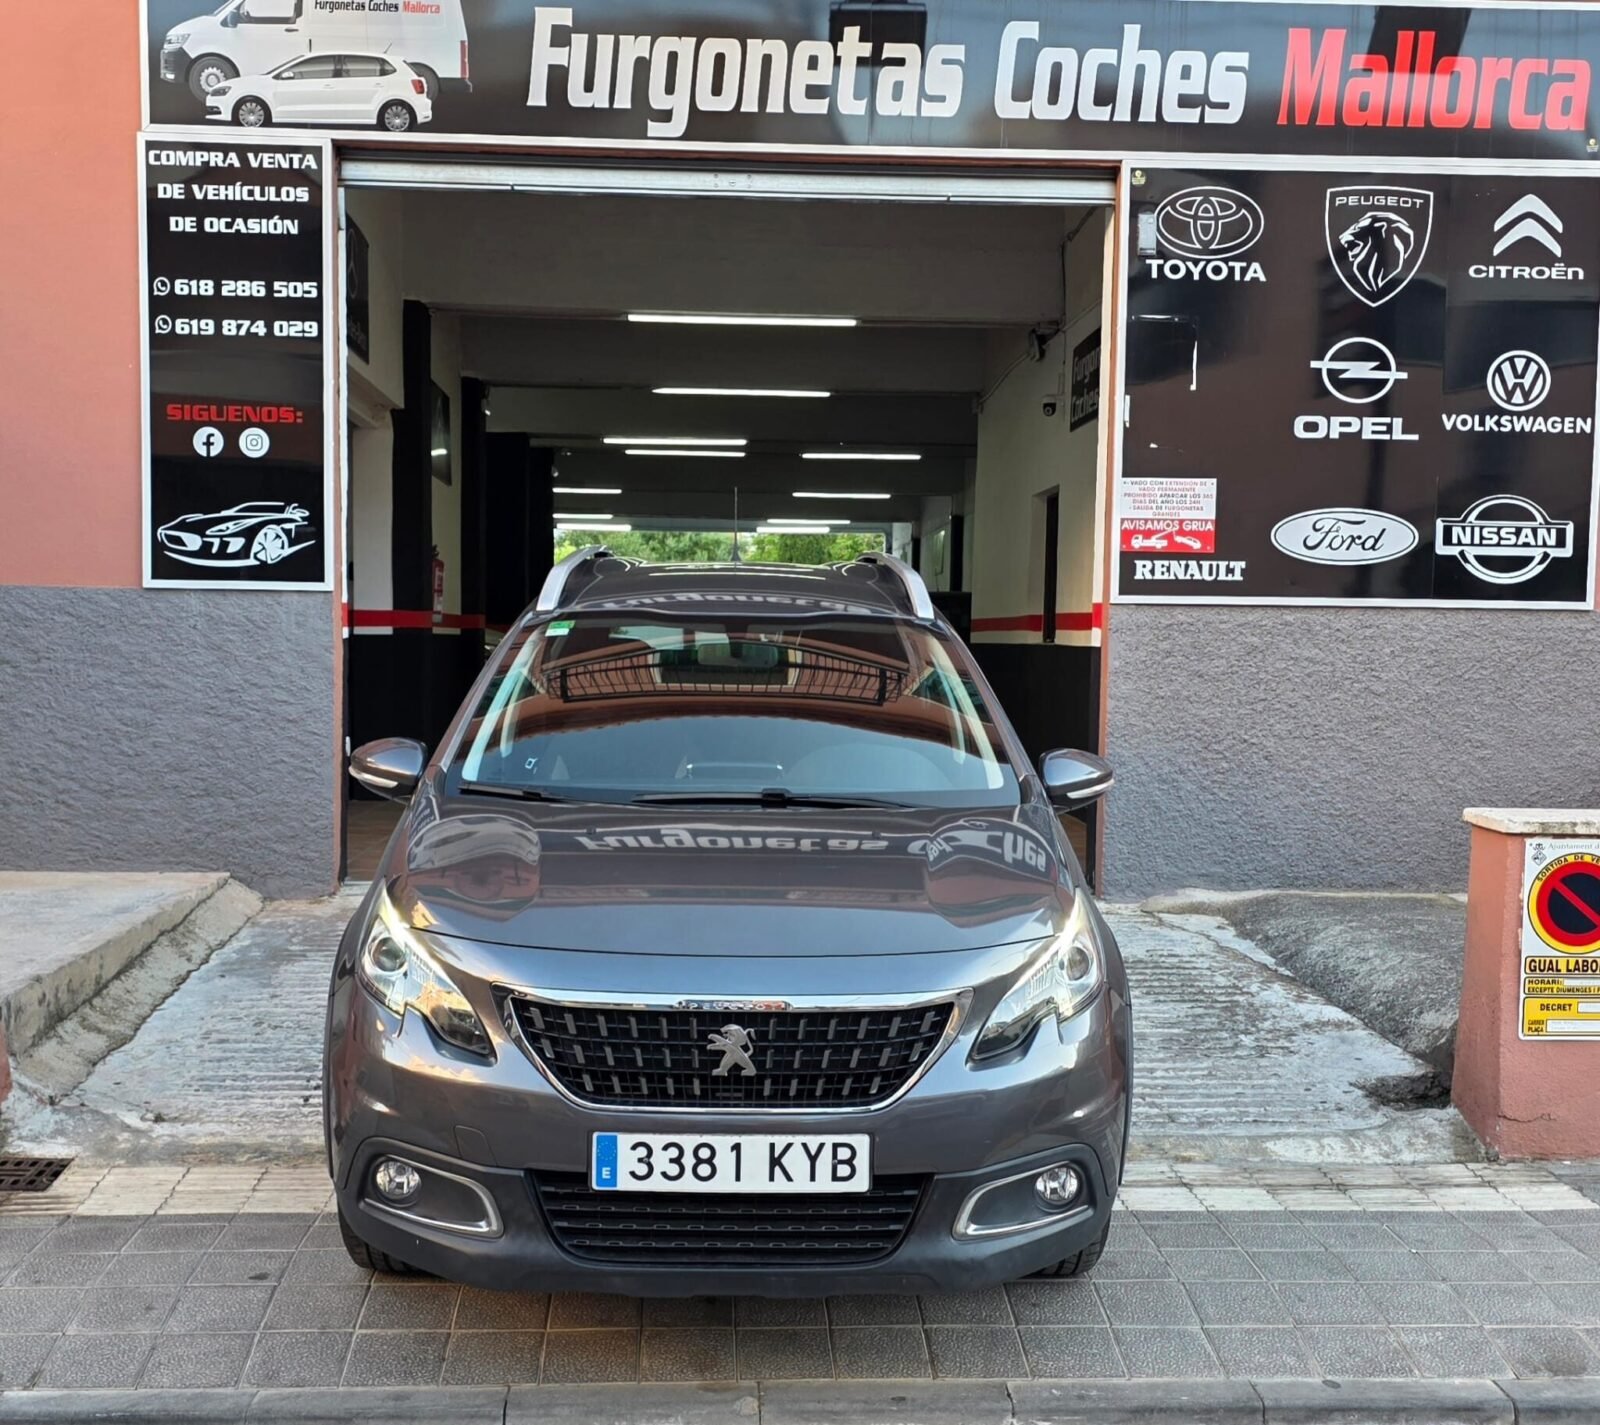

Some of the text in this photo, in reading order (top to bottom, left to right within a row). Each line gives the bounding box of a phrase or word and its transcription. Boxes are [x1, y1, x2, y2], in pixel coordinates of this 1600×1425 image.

[315, 0, 440, 13] Furgonetas Coches Mallorca
[526, 6, 1591, 138] Furgonetas Coches Mallorca
[148, 150, 317, 170] COMPRA VENTA
[157, 181, 309, 202] DE VEHÍCULOS
[1335, 196, 1424, 209] PEUGEOT
[169, 215, 299, 235] DE OCASIÓN
[1146, 259, 1267, 283] TOYOTA
[174, 279, 318, 297] 618 286 505
[175, 318, 318, 337] 619 874 029
[166, 404, 303, 423] SIGUENOS:
[1294, 415, 1419, 441] OPEL
[1442, 414, 1591, 434] VOLKSWAGEN
[1122, 520, 1214, 531] AVISAMOS GRUA
[1303, 517, 1385, 552] Ford
[1452, 526, 1557, 547] NISSAN
[1134, 560, 1246, 581] RENAULT
[1537, 857, 1569, 882] SORTIDA
[1528, 959, 1600, 973] GUAL LABO
[1540, 1003, 1573, 1011] DECRET
[629, 1142, 857, 1183] 3381 KYB
[602, 1168, 611, 1179] E
